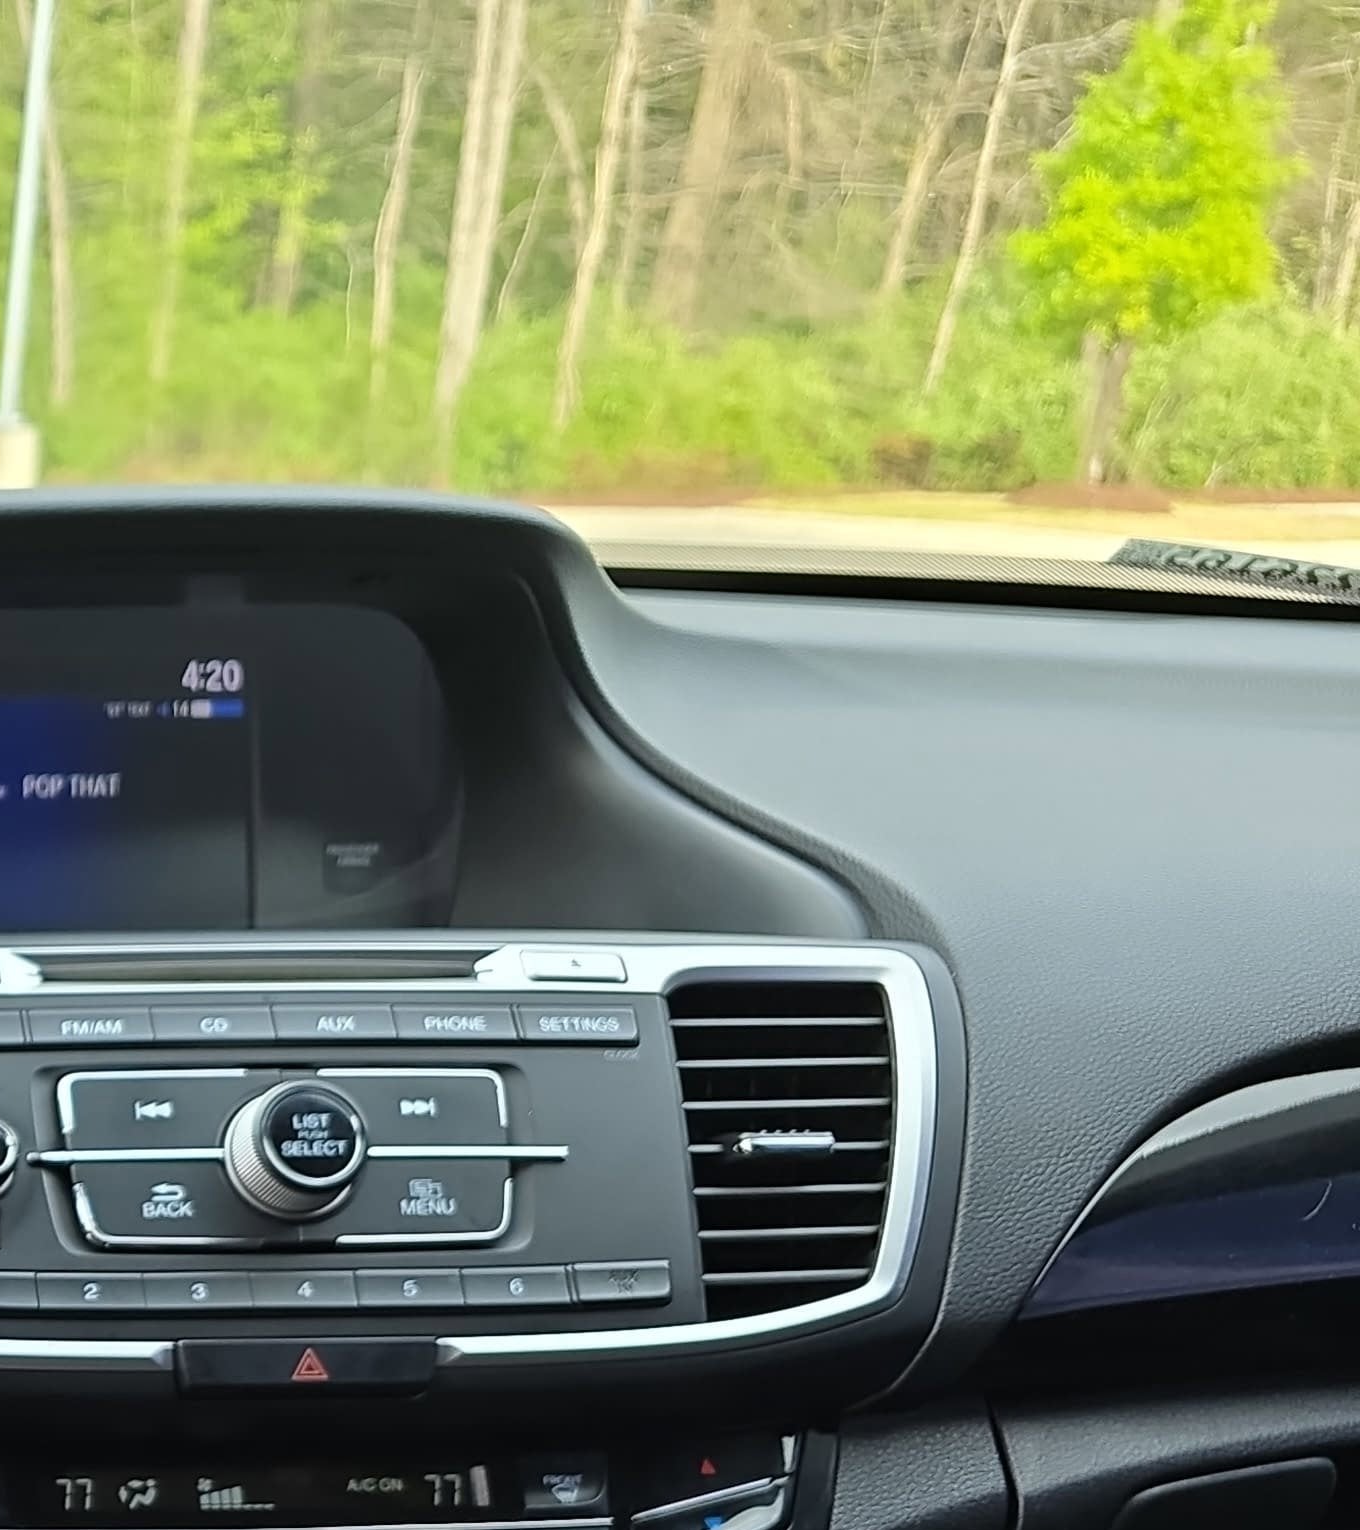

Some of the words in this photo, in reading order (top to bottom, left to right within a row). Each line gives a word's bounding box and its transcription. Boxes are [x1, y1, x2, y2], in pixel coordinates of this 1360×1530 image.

[181, 660, 244, 692] 4:20
[69, 772, 121, 799] THAT
[61, 1018, 123, 1036] FM/AM
[199, 1016, 228, 1034] CD
[317, 1015, 355, 1033] AUX
[423, 1015, 487, 1032] PHONE
[538, 1016, 620, 1033] SETTINGS
[292, 1112, 331, 1130] LIST
[281, 1140, 348, 1157] SELECT
[142, 1201, 194, 1219] BACK
[400, 1199, 456, 1216] MENU
[83, 1283, 102, 1300] 2
[190, 1282, 209, 1300] 3
[297, 1281, 313, 1298] 4
[402, 1280, 418, 1296] 5
[509, 1278, 524, 1295] 6
[56, 1477, 95, 1510] 77
[346, 1477, 377, 1492] A/C
[381, 1479, 405, 1493] ON
[424, 1473, 461, 1506] 77
